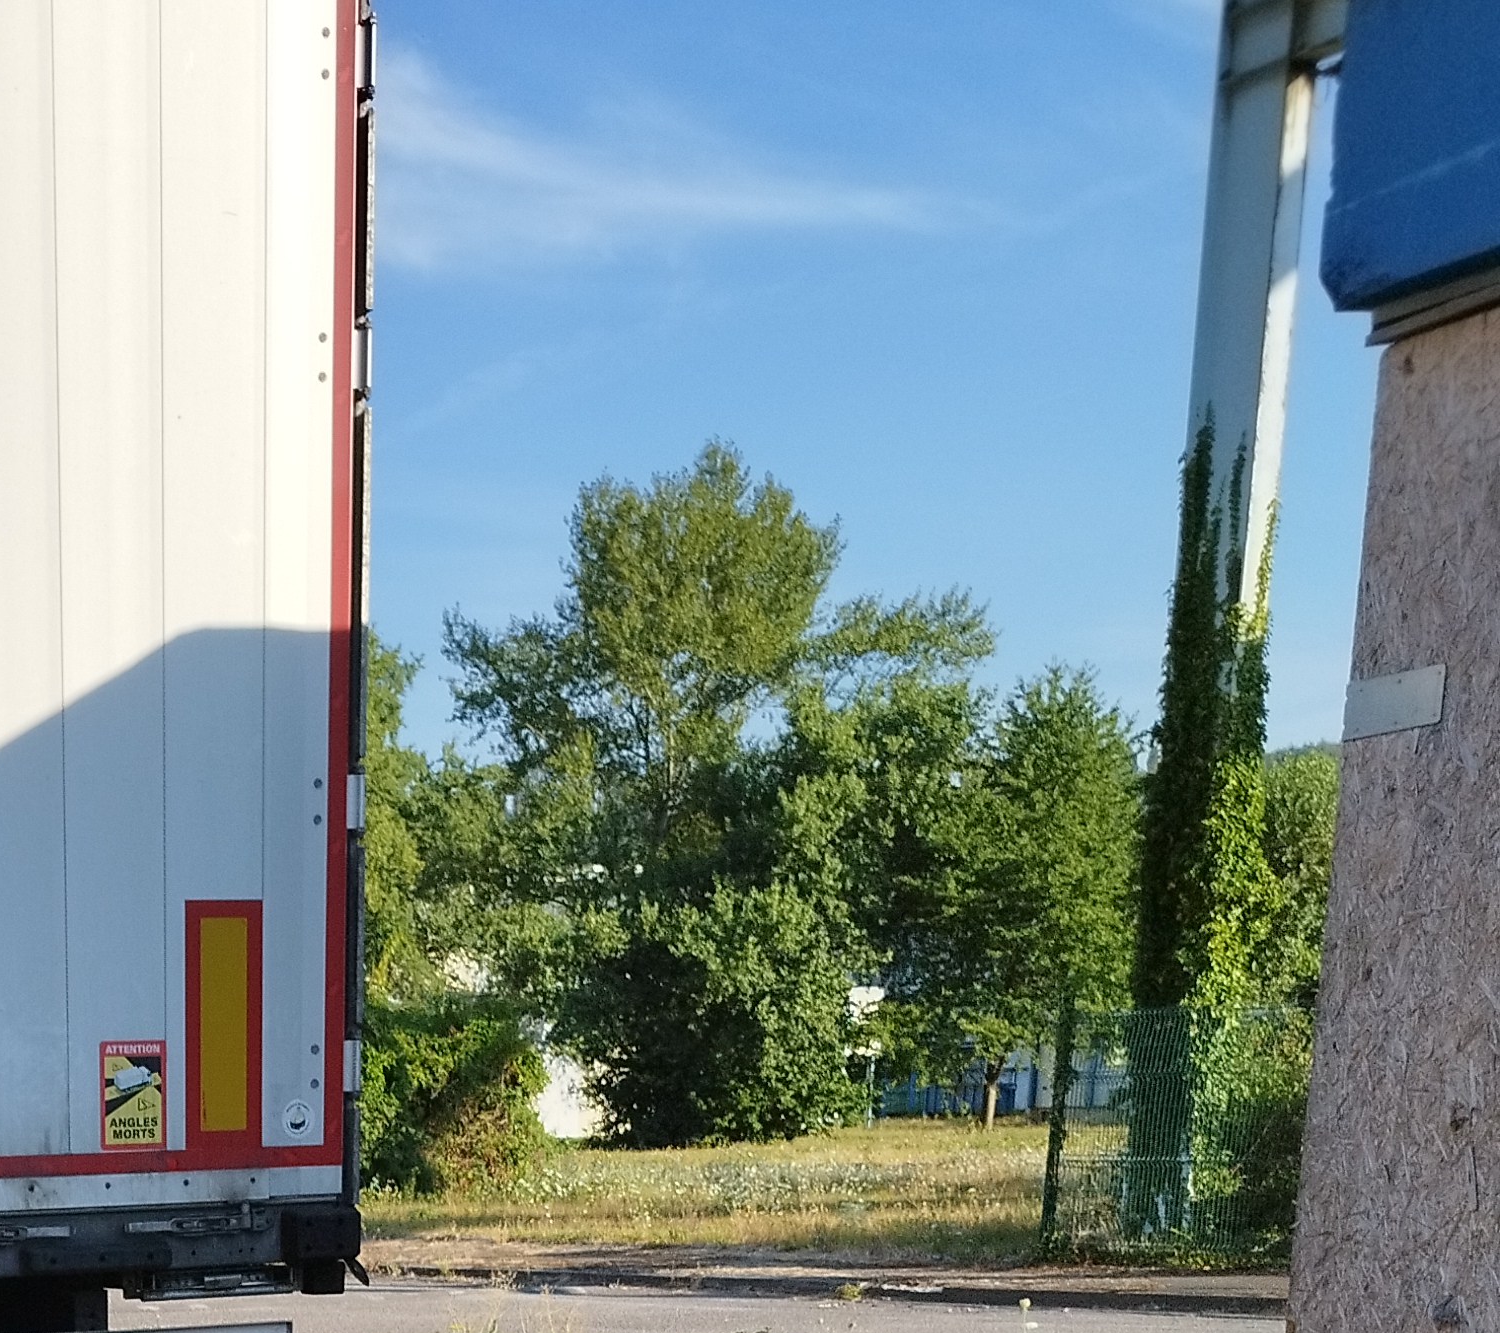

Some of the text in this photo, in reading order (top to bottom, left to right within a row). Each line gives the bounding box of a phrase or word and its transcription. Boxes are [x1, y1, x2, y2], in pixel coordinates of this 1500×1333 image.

[105, 1044, 160, 1055] ATTENTION
[109, 1116, 158, 1128] ANGLES
[112, 1128, 155, 1140] MORTS
